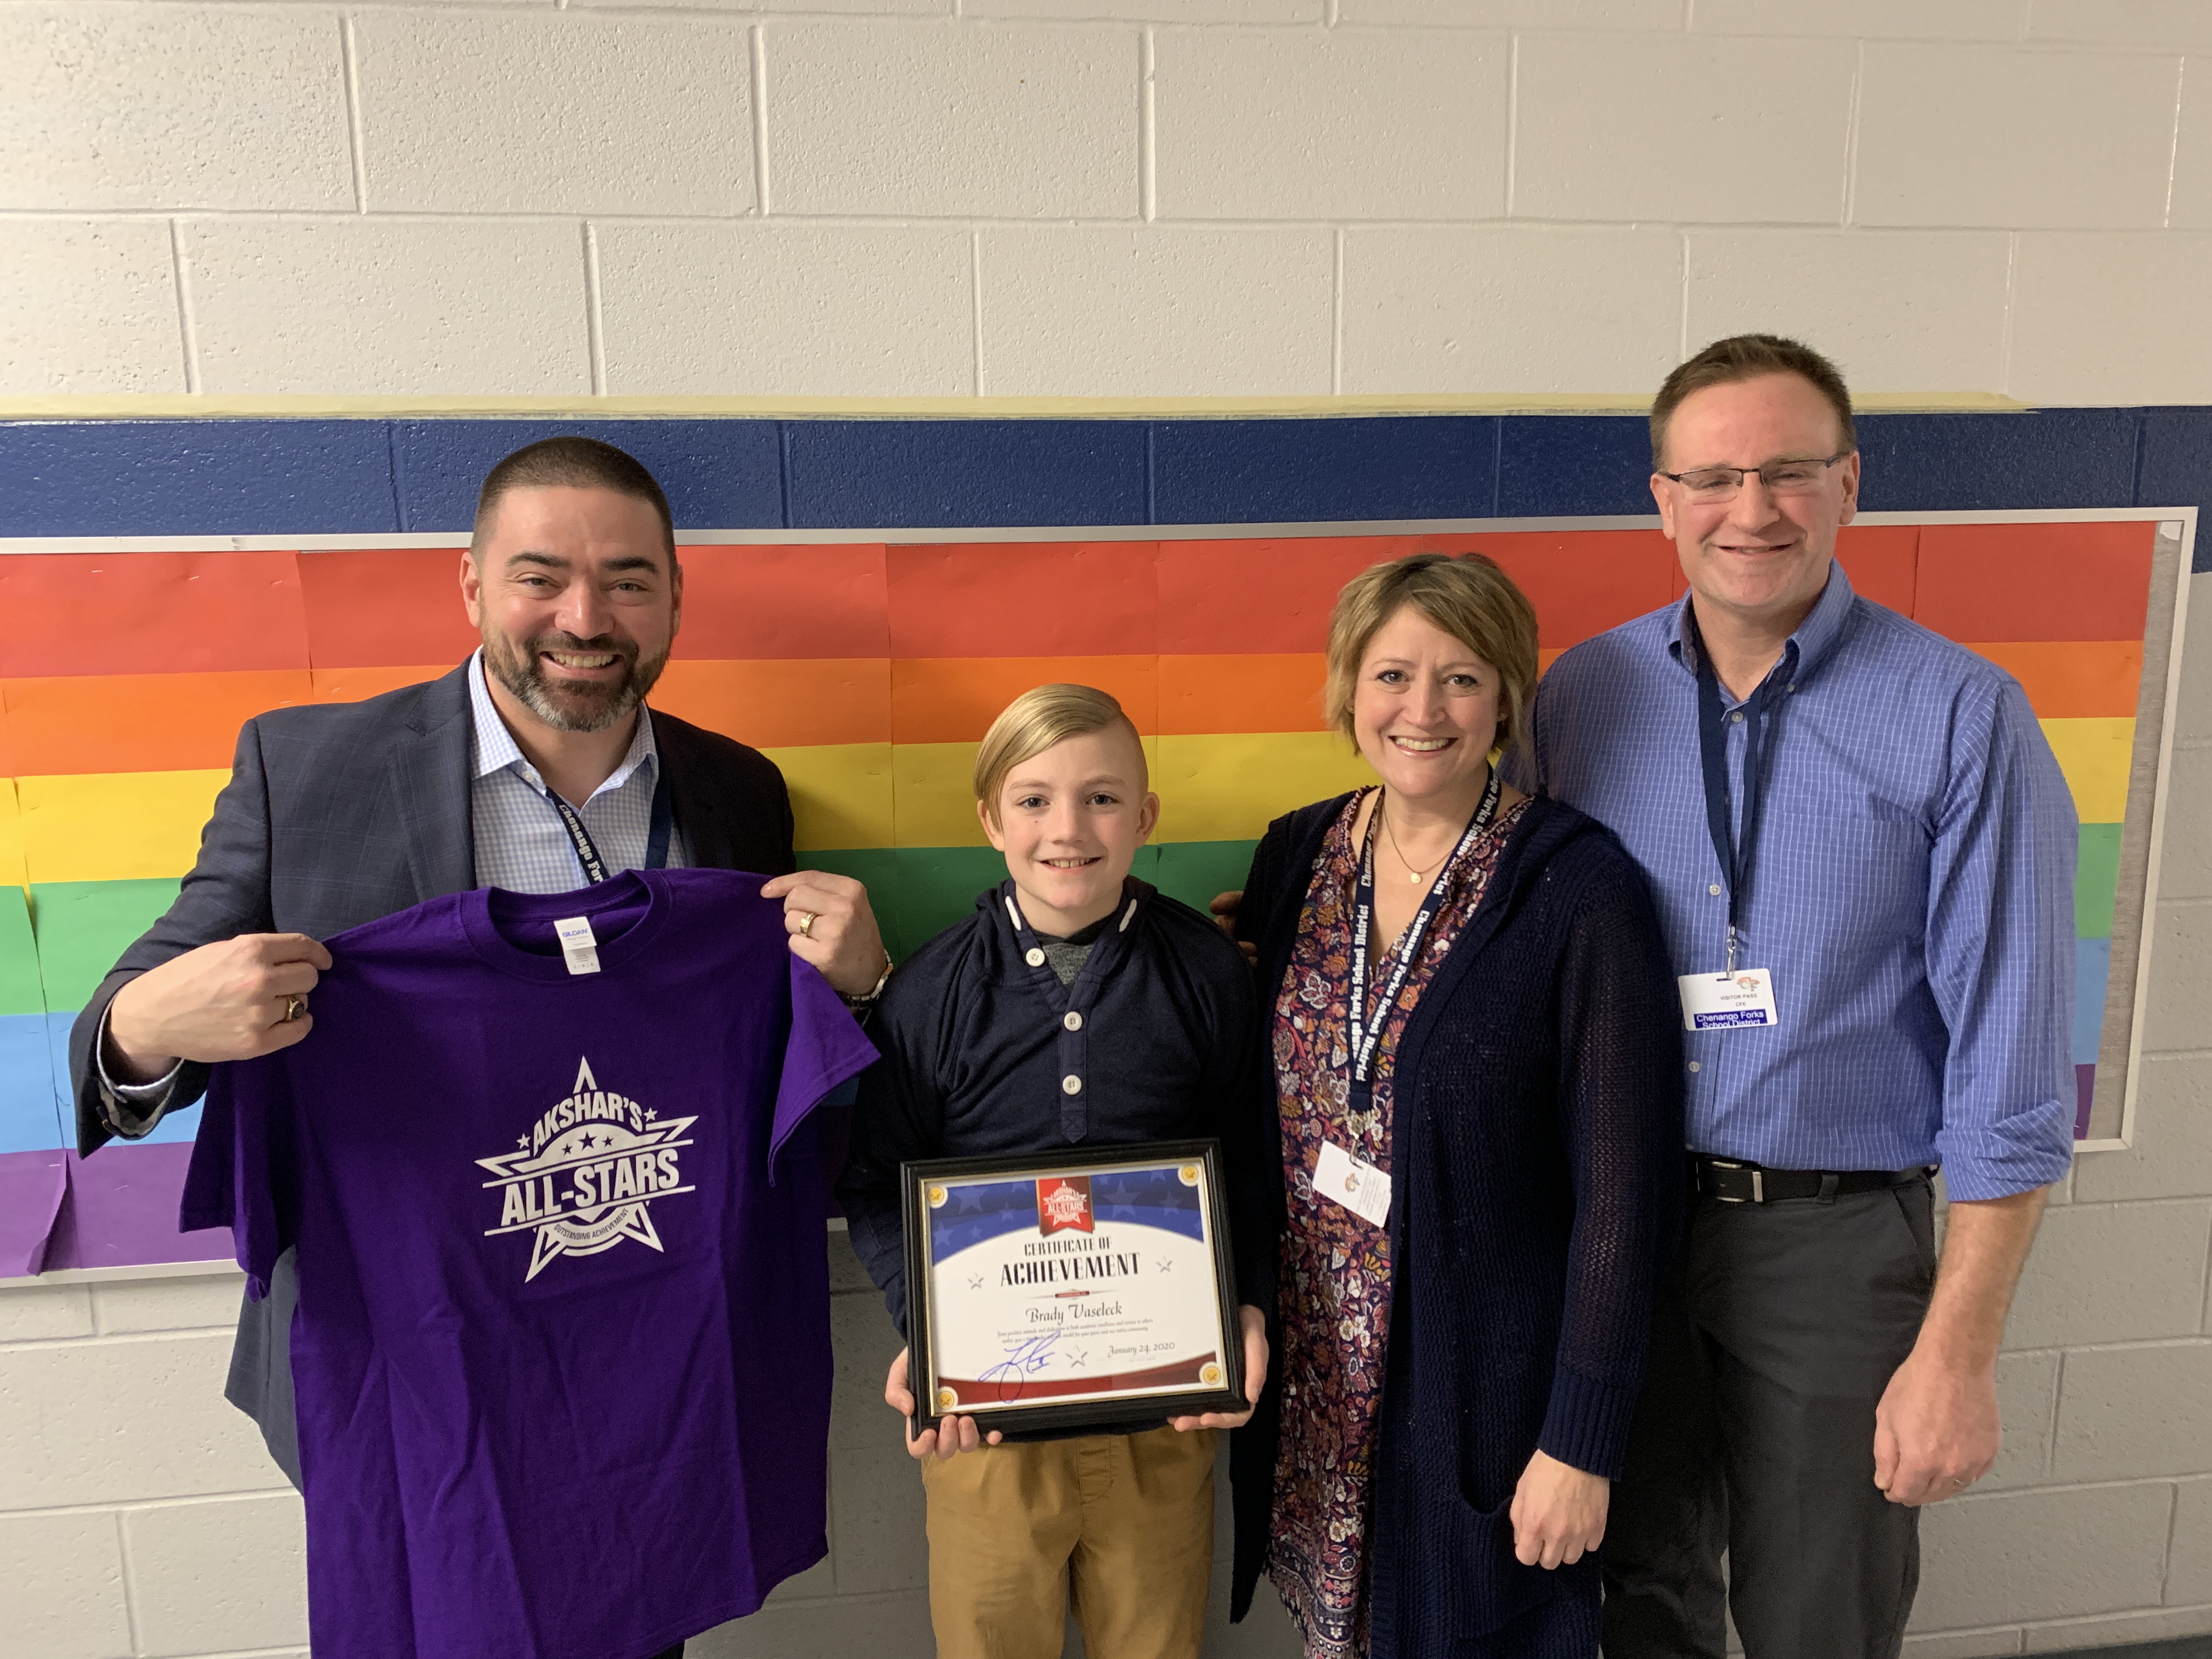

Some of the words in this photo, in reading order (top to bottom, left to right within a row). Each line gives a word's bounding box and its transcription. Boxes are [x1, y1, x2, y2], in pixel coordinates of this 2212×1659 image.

[558, 804, 592, 860] Chenango
[1354, 905, 1369, 945] District
[1401, 910, 1430, 963] Chenango
[1352, 947, 1365, 985] School
[1386, 964, 1408, 997] Forks
[1350, 986, 1363, 1020] Forks
[1369, 996, 1392, 1035] School
[1696, 1013, 1739, 1022] Chenango
[1740, 1011, 1764, 1019] Forks
[1702, 1020, 1732, 1029] School
[1355, 1035, 1376, 1082] District
[533, 1091, 643, 1157] AKSHAR'S
[501, 1148, 680, 1227] ALL-STARS
[554, 1224, 590, 1240] OUTSTANDING
[592, 1207, 629, 1238] ACHIEVEMENT
[1024, 1237, 1095, 1257] CERTIFICATE
[1098, 1235, 1112, 1250] OF
[1001, 1251, 1141, 1287] ACHIEVEMENT
[1025, 1306, 1064, 1325] Brady
[1107, 1345, 1137, 1358] January
[1153, 1341, 1175, 1351] 2020
